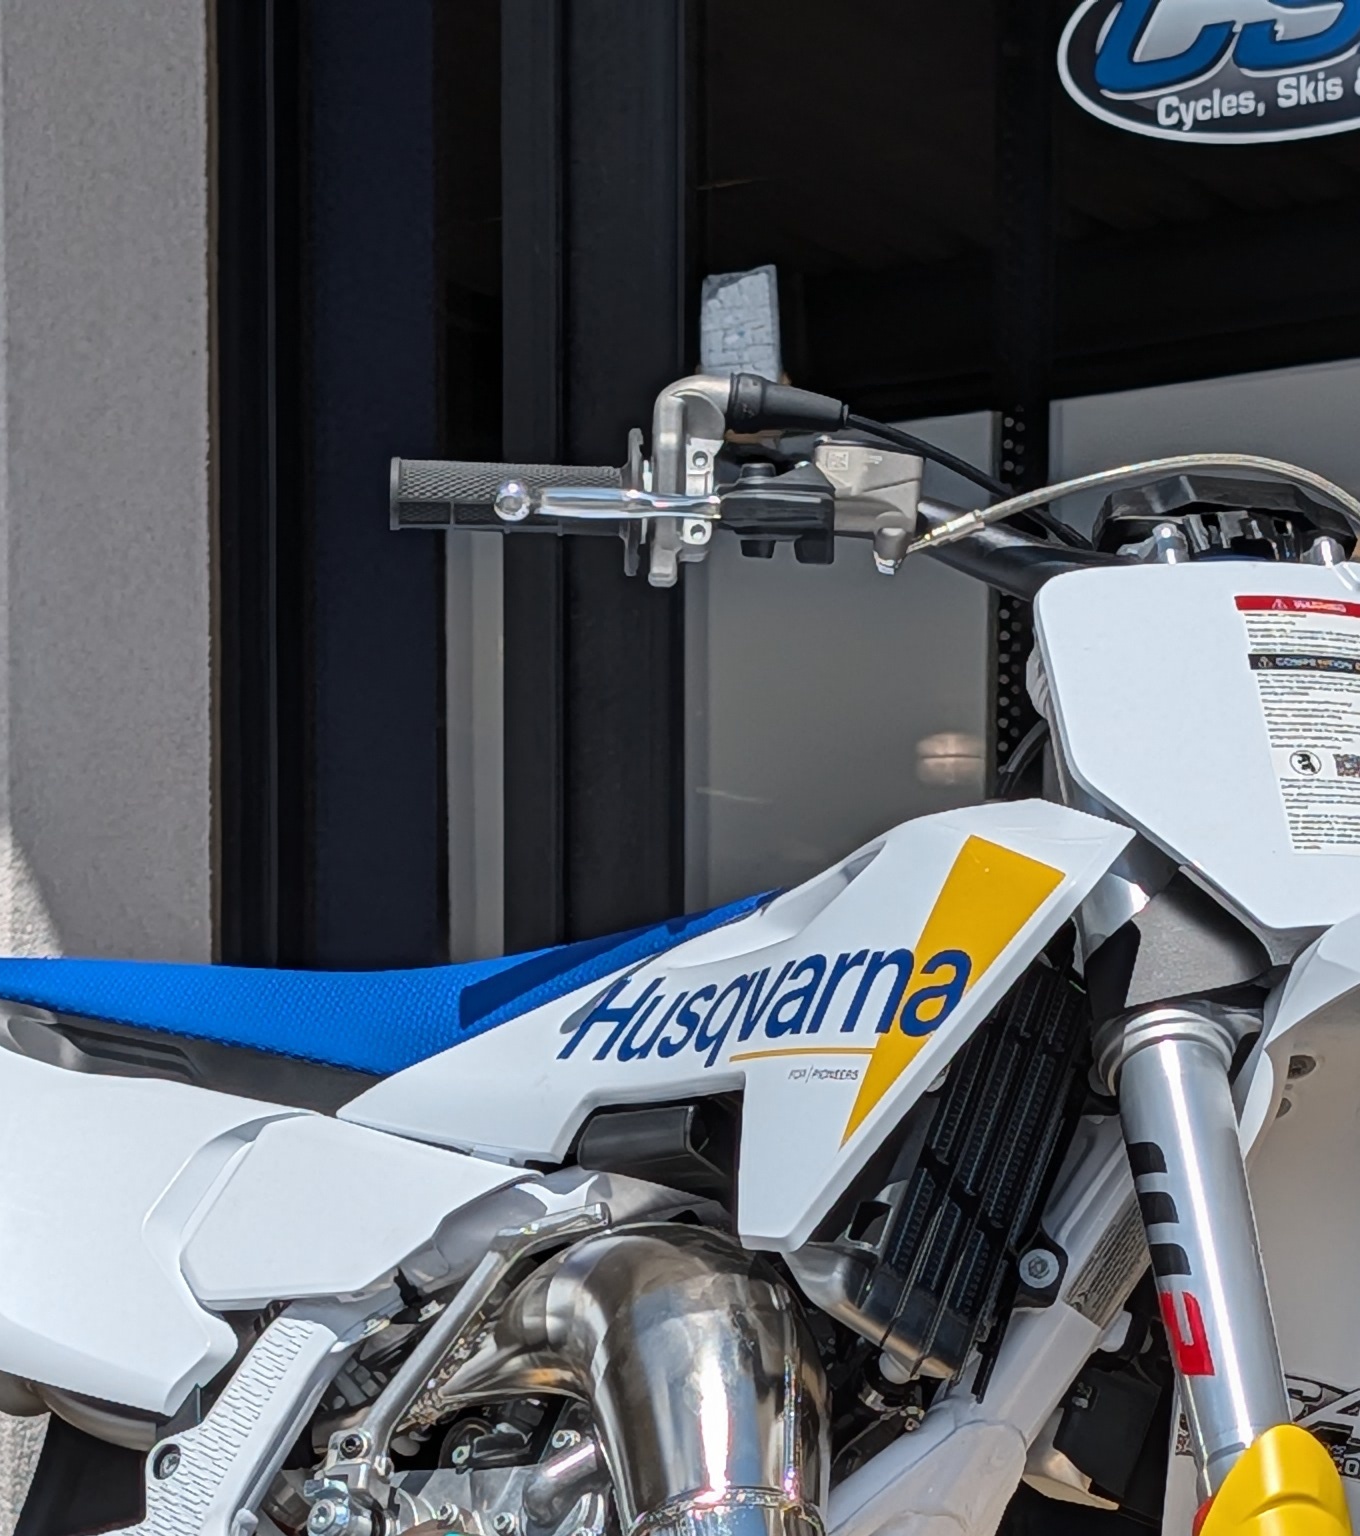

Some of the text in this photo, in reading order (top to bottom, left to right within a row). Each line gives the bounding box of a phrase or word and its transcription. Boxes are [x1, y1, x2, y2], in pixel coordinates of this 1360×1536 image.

[1156, 88, 1265, 132] Cycles,
[1277, 72, 1344, 109] Skis
[556, 947, 972, 1068] Husqvarna
